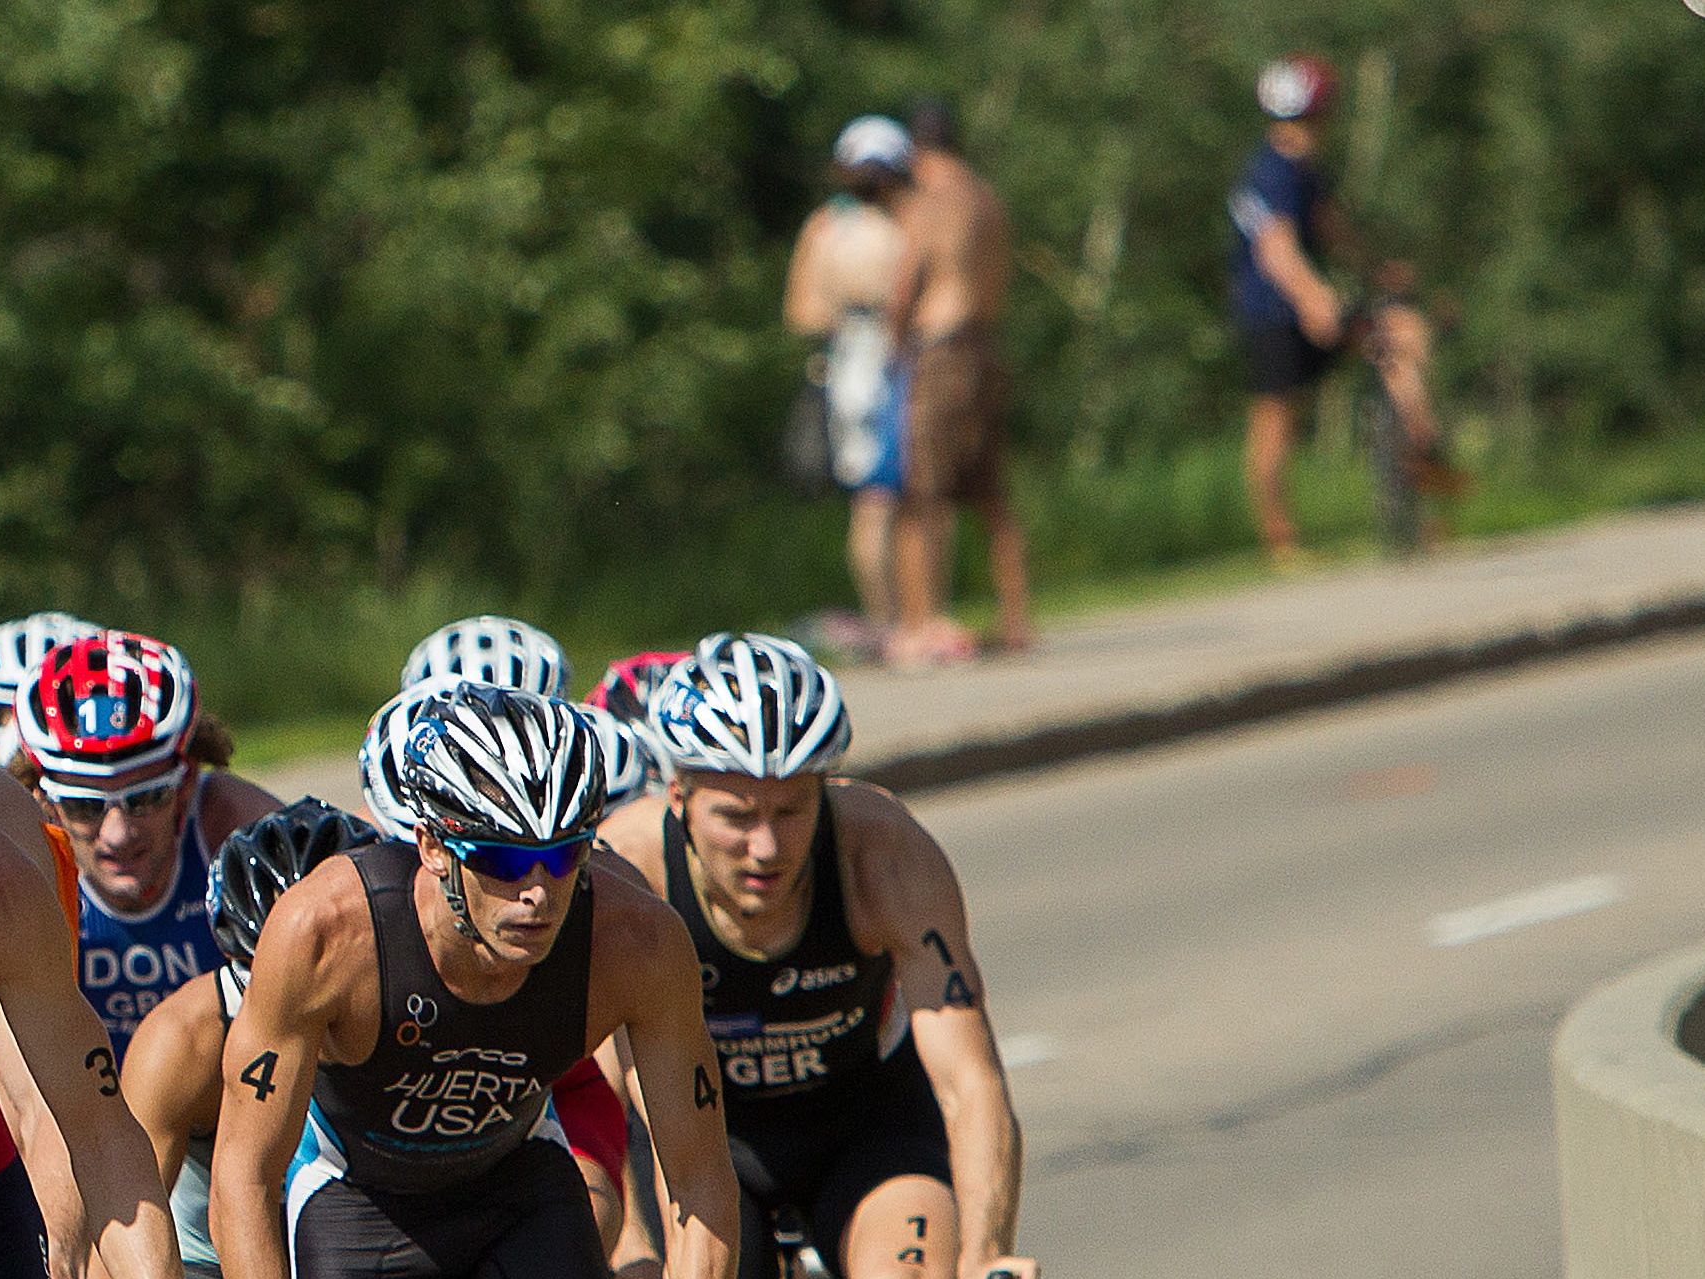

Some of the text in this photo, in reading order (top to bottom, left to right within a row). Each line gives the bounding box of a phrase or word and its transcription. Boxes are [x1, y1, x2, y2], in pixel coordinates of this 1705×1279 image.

[78, 699, 97, 734] 1
[84, 942, 200, 988] DON
[85, 1047, 119, 1097] 3
[240, 1050, 279, 1102] 4
[383, 1070, 542, 1102] HUERTA
[694, 1065, 718, 1110] 4
[726, 1049, 828, 1086] GER
[391, 1100, 514, 1136] USA
